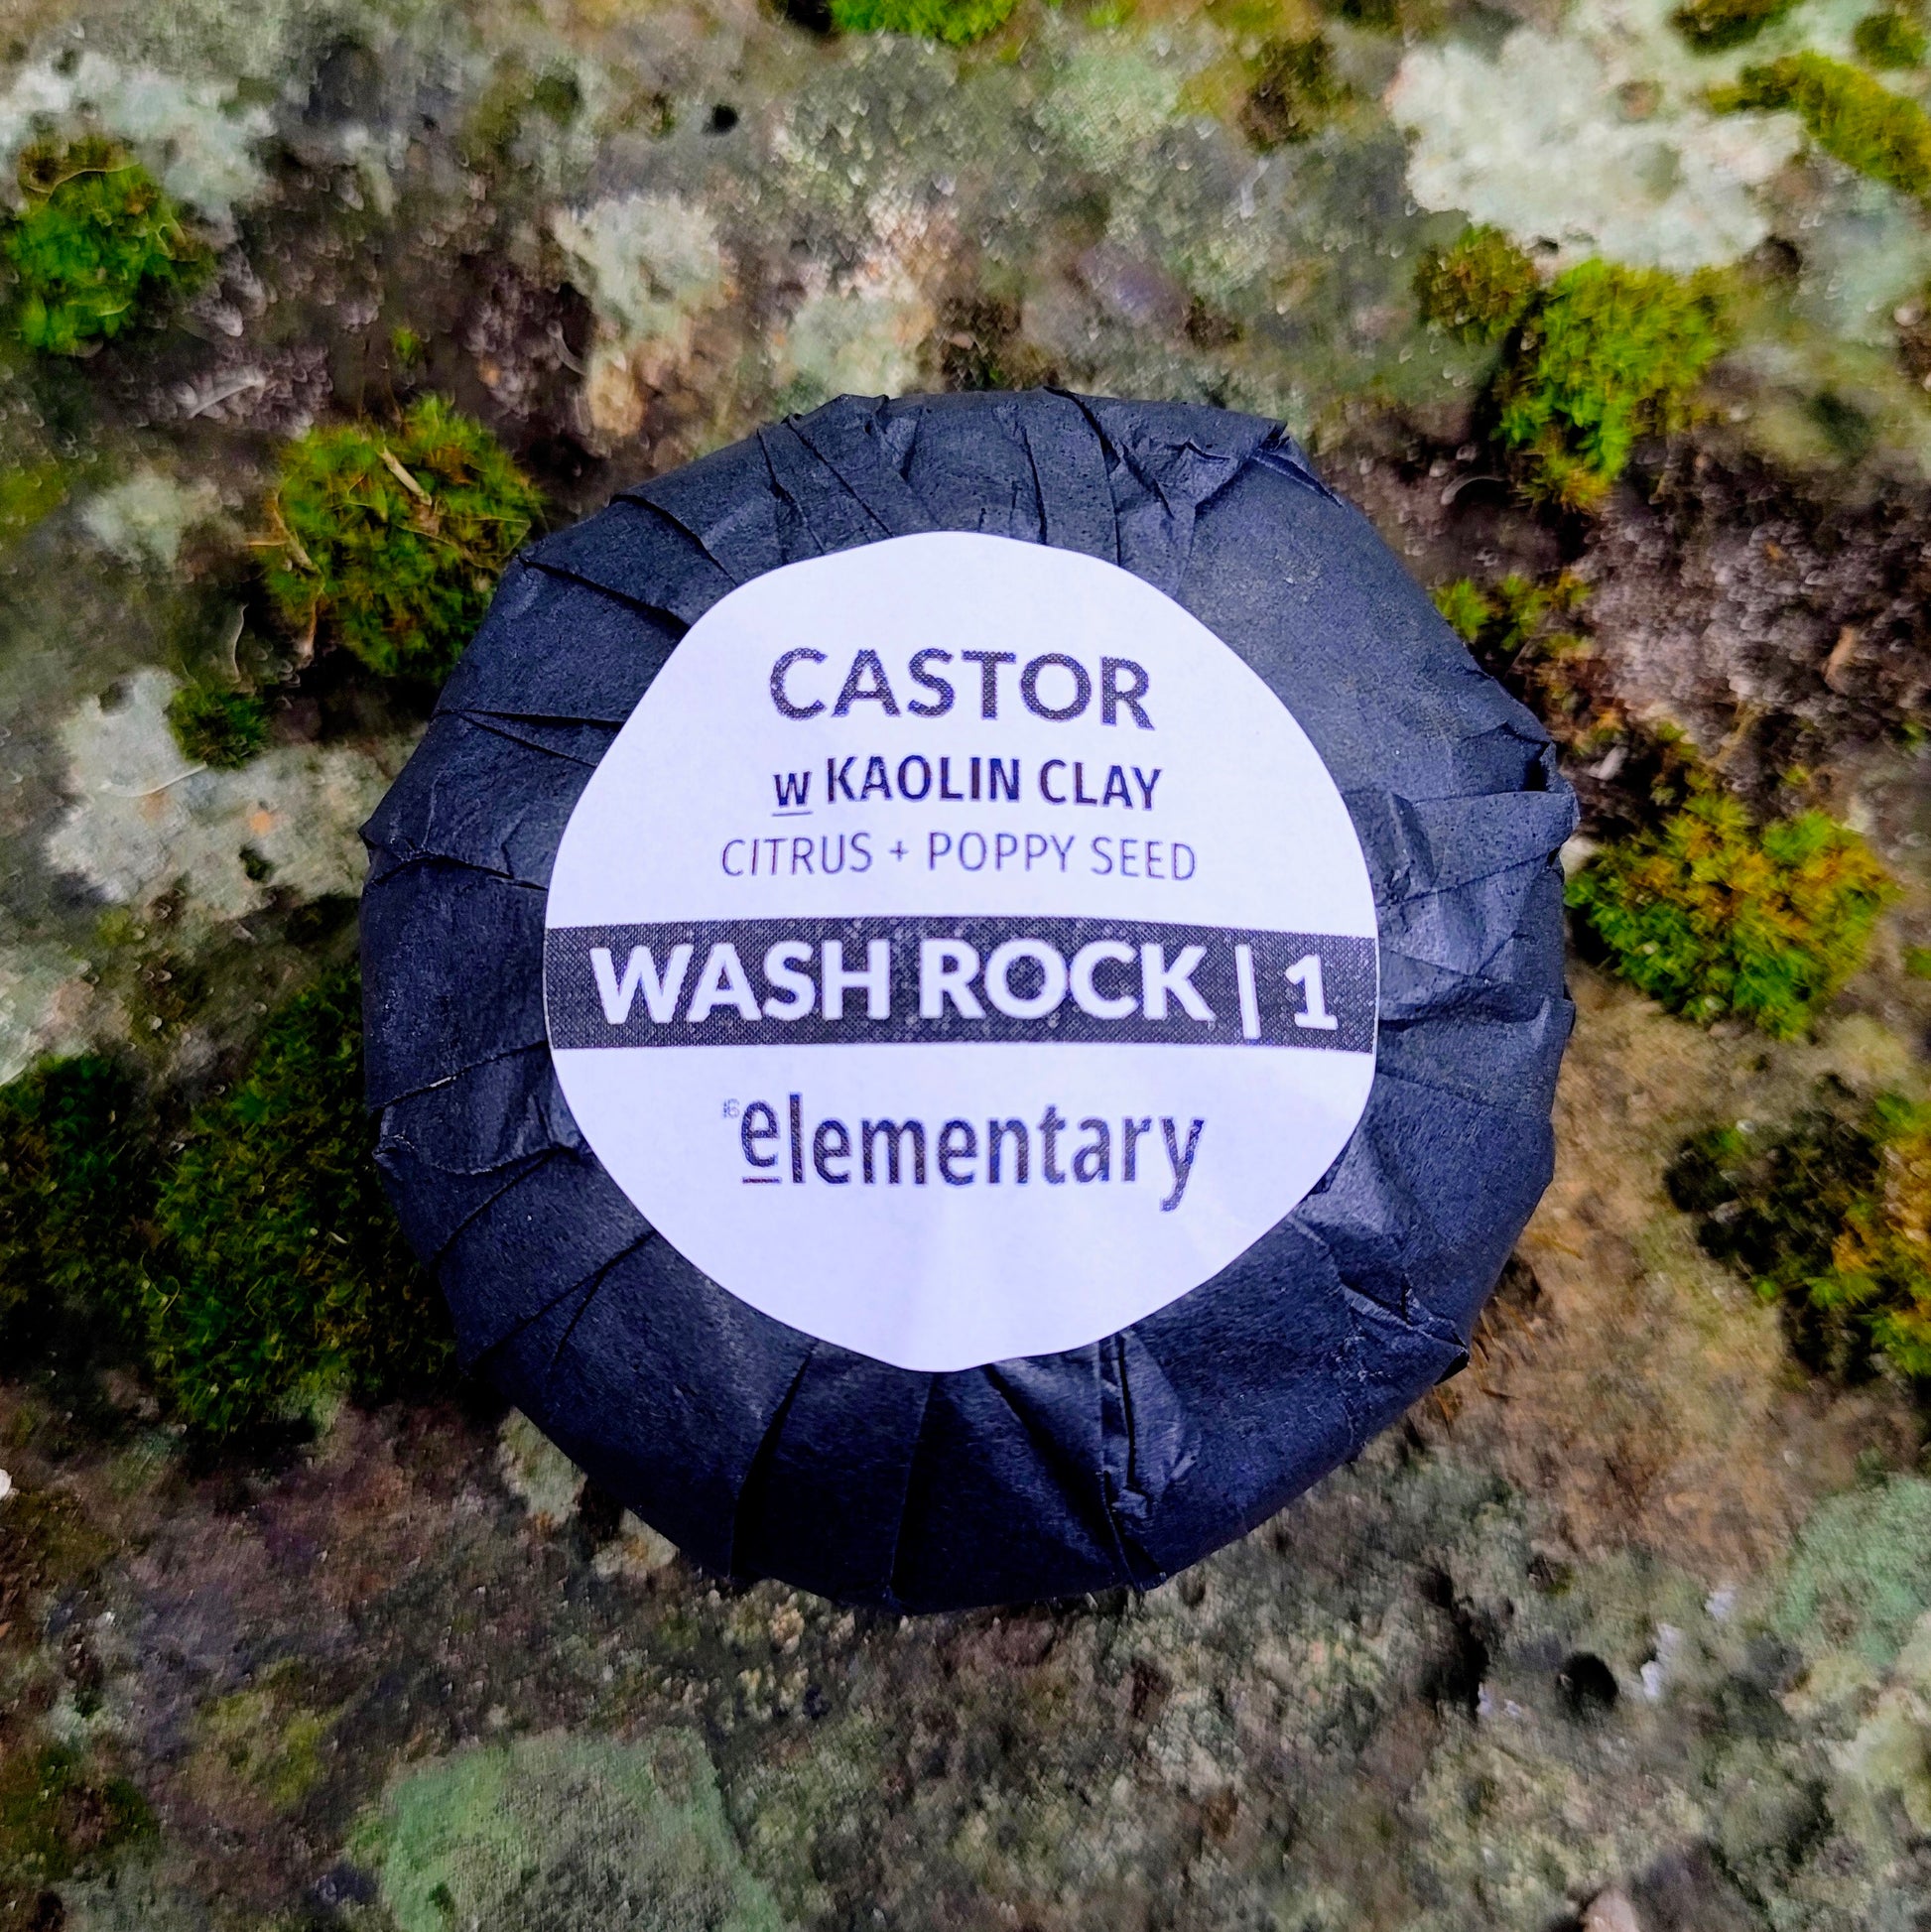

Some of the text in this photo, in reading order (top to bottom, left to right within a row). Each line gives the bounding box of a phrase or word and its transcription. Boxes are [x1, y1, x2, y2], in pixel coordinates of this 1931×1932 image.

[769, 647, 1156, 729] CASTOR
[827, 754, 1021, 805] KAOLIN
[1038, 758, 1162, 810] CLAY
[720, 832, 873, 877] CITRUS
[928, 832, 1077, 873] POPPY
[1092, 837, 1197, 881] SEED
[587, 938, 892, 1025] WASH
[917, 936, 1218, 1027] ROCK
[1280, 952, 1340, 1032] 1
[740, 1094, 1206, 1213] elementary
